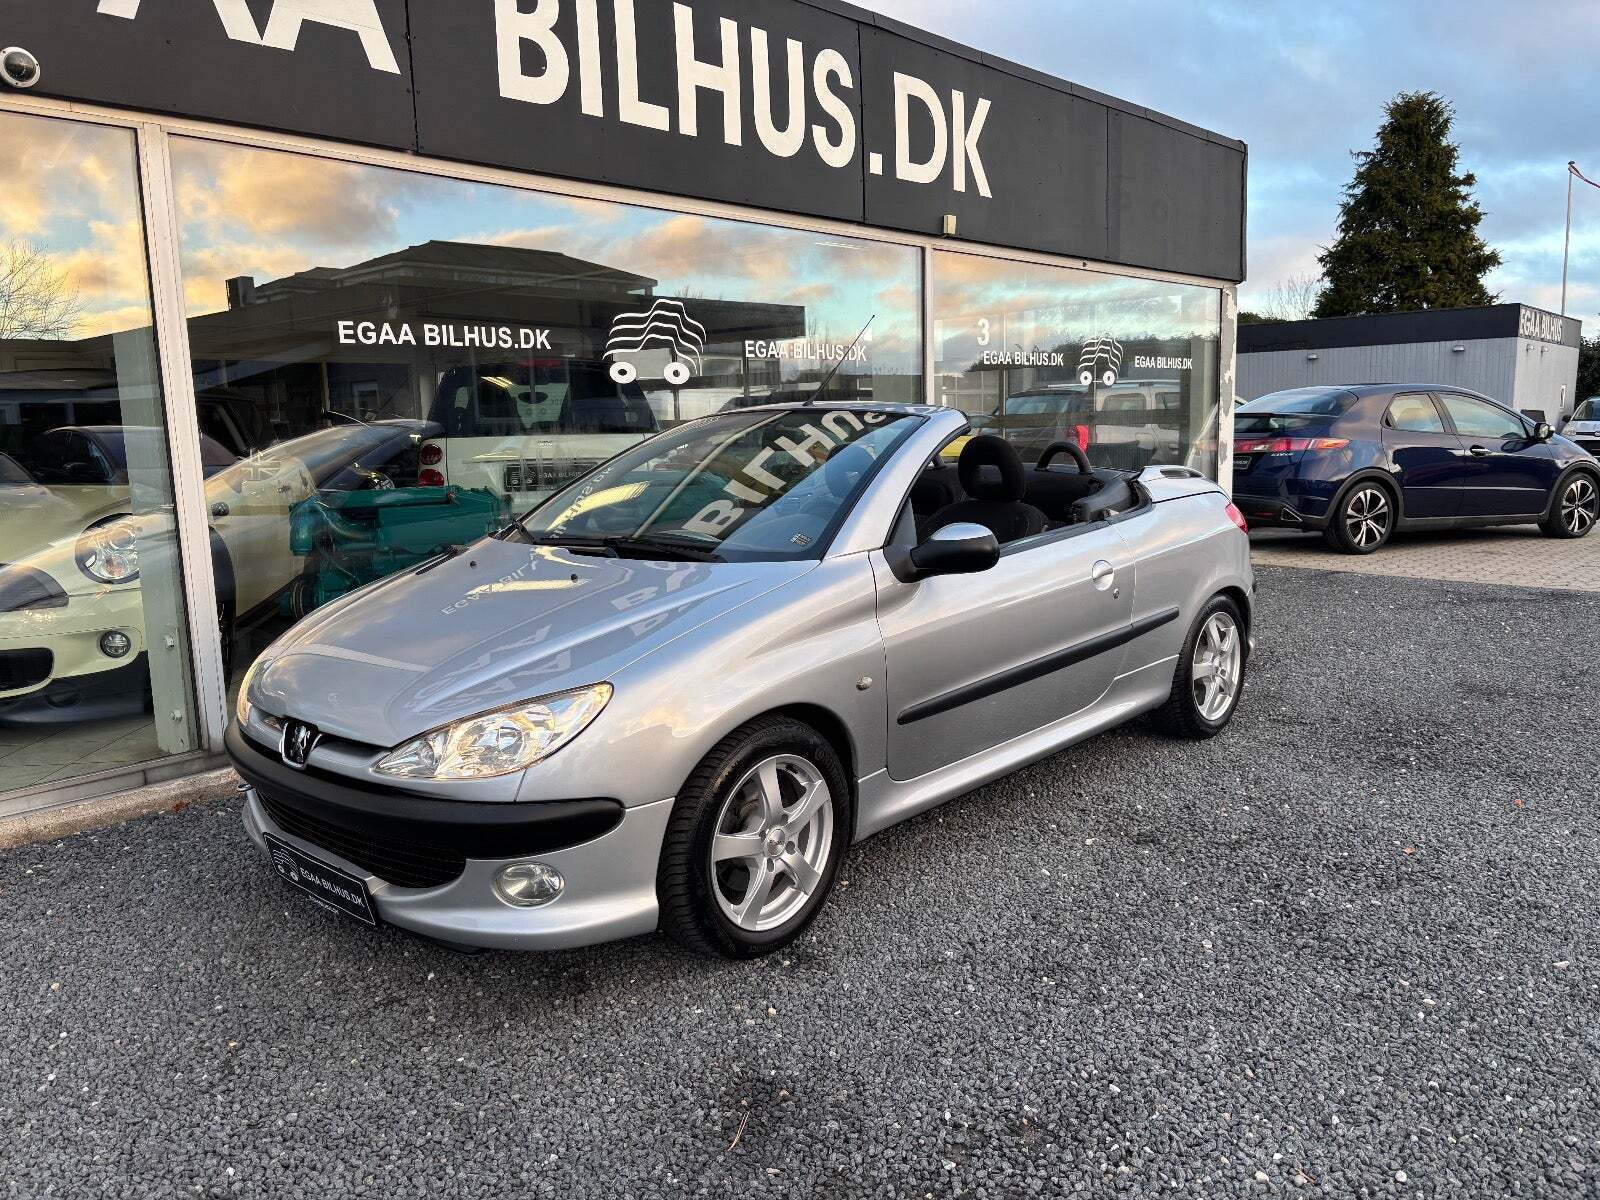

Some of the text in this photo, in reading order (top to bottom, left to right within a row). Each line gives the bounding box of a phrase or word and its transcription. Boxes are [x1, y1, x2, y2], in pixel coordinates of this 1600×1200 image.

[495, 0, 992, 199] BILHUS.DK
[338, 320, 551, 350] EGAA BILHUS.DK
[1519, 309, 1563, 342] EGAA BILHUS
[744, 340, 867, 362] EGAA BILHUS.DK
[983, 350, 1064, 367] EGAA BILHUS.DK
[1134, 355, 1193, 370] EGAA BILHUS.DK
[300, 866, 322, 887] EGAA
